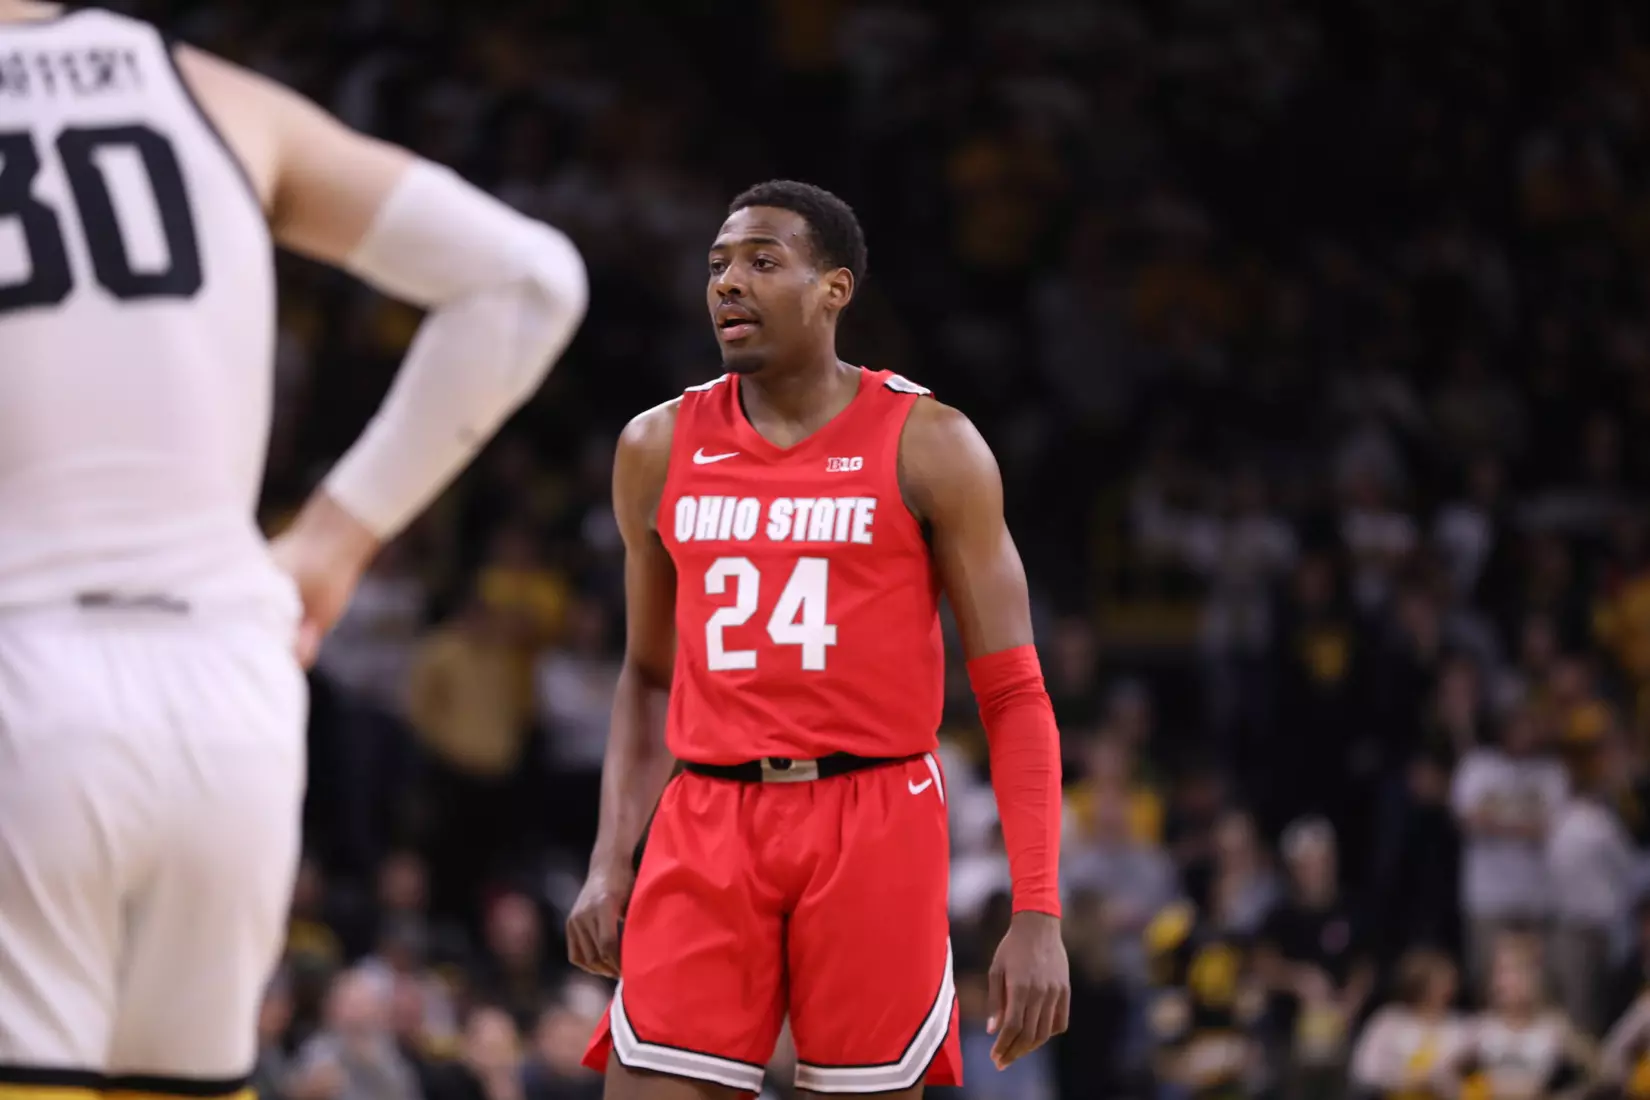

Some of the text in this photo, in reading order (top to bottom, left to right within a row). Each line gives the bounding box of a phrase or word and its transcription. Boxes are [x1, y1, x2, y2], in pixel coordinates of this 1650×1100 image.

[674, 495, 877, 545] OHIO STATE
[704, 556, 838, 671] 24
